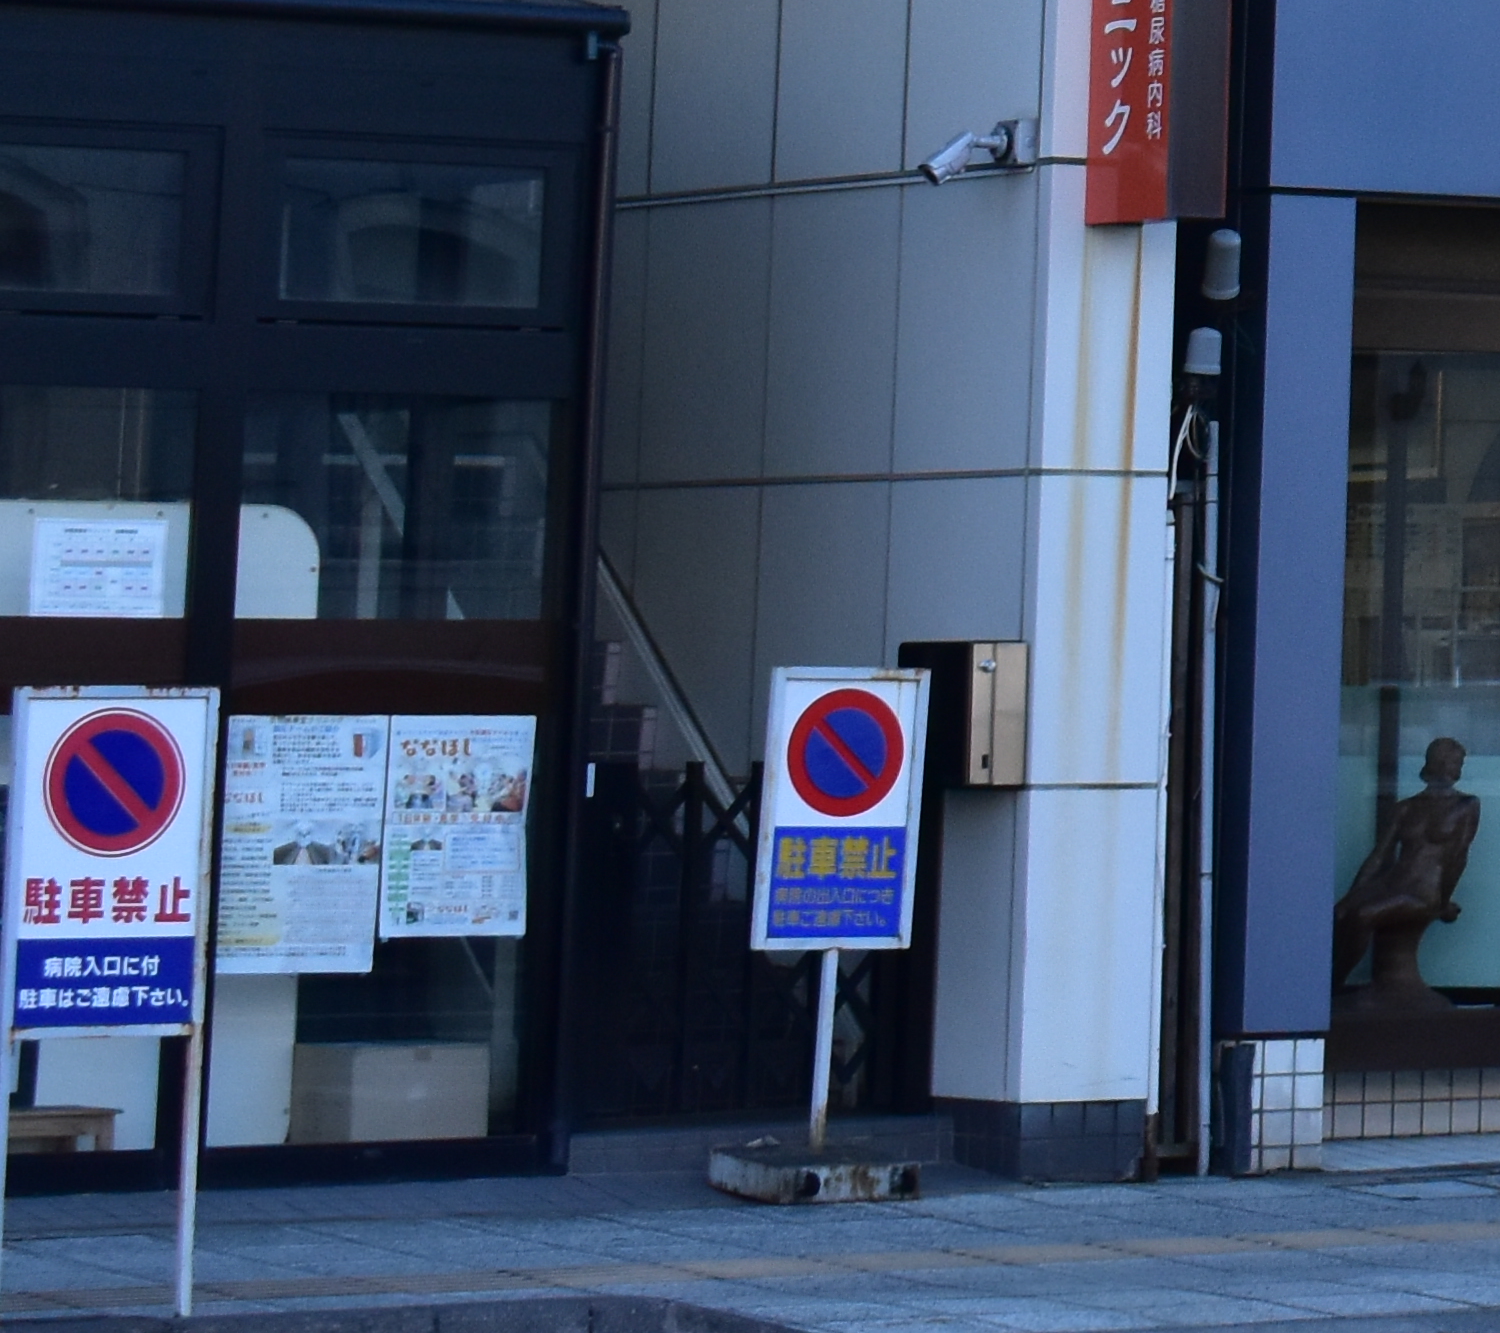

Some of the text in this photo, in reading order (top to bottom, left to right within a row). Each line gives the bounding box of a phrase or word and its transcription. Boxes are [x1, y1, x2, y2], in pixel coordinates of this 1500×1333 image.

[776, 836, 897, 880] 駐車禁止
[23, 875, 192, 925] 駐車禁止
[43, 955, 161, 978] 病院入口に付
[18, 986, 190, 1010] 駐車はご遠慮下さい。
